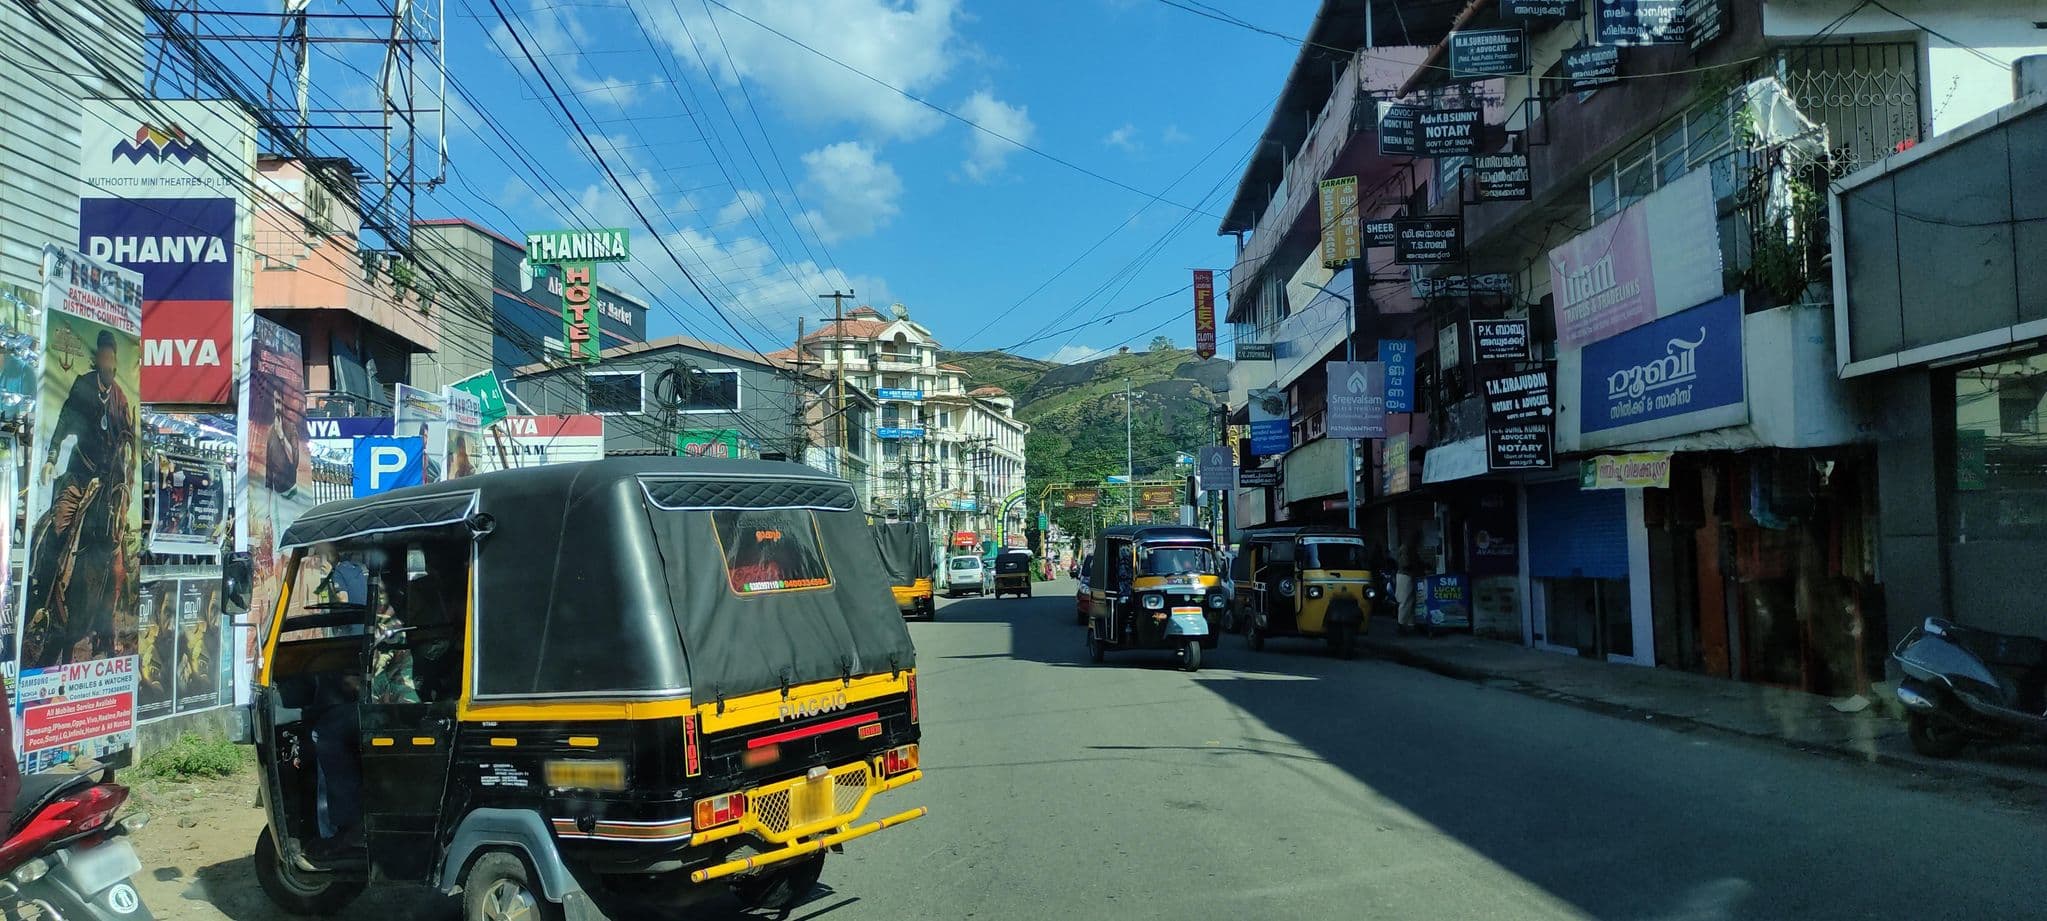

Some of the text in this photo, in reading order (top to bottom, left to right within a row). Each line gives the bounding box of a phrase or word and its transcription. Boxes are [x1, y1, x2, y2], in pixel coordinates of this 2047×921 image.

[1426, 125, 1471, 138] NOTARY
[88, 177, 139, 187] MUTHOOTTU
[141, 177, 158, 187] MINI
[160, 177, 201, 187] THEATRES
[203, 177, 215, 187] (P)
[1321, 177, 1356, 188] SARANYA
[1367, 223, 1393, 233] SHEEB
[90, 236, 228, 263] DHANYA
[528, 232, 626, 260] THANIMA
[63, 298, 135, 332] DISTRICT COMMITTEE
[565, 266, 591, 359] HOTEL
[608, 302, 632, 326] Market
[1197, 289, 1213, 331] FLEX
[1197, 332, 1214, 343] CLOTH
[1479, 323, 1525, 337] P.K. ബാബു
[141, 339, 221, 366] MYA
[1332, 394, 1383, 405] Sreevalsam
[1492, 394, 1549, 413] NOTARY & ADVOCATE
[307, 421, 341, 437] NYA
[1525, 424, 1546, 433] KUMAR
[1497, 444, 1543, 452] NOTARY
[370, 446, 408, 490] P
[1434, 585, 1462, 593] LUCKY
[1439, 577, 1457, 586] SM
[69, 657, 133, 682] MY CARE
[21, 677, 48, 689] SAMSUNG
[69, 681, 97, 693] MOBILES
[104, 675, 132, 686] WATCHES
[69, 689, 91, 700] Contact
[47, 698, 117, 717] All Mobiles Service Available
[778, 692, 848, 723] PIAGGIO
[684, 715, 698, 775] STOP
